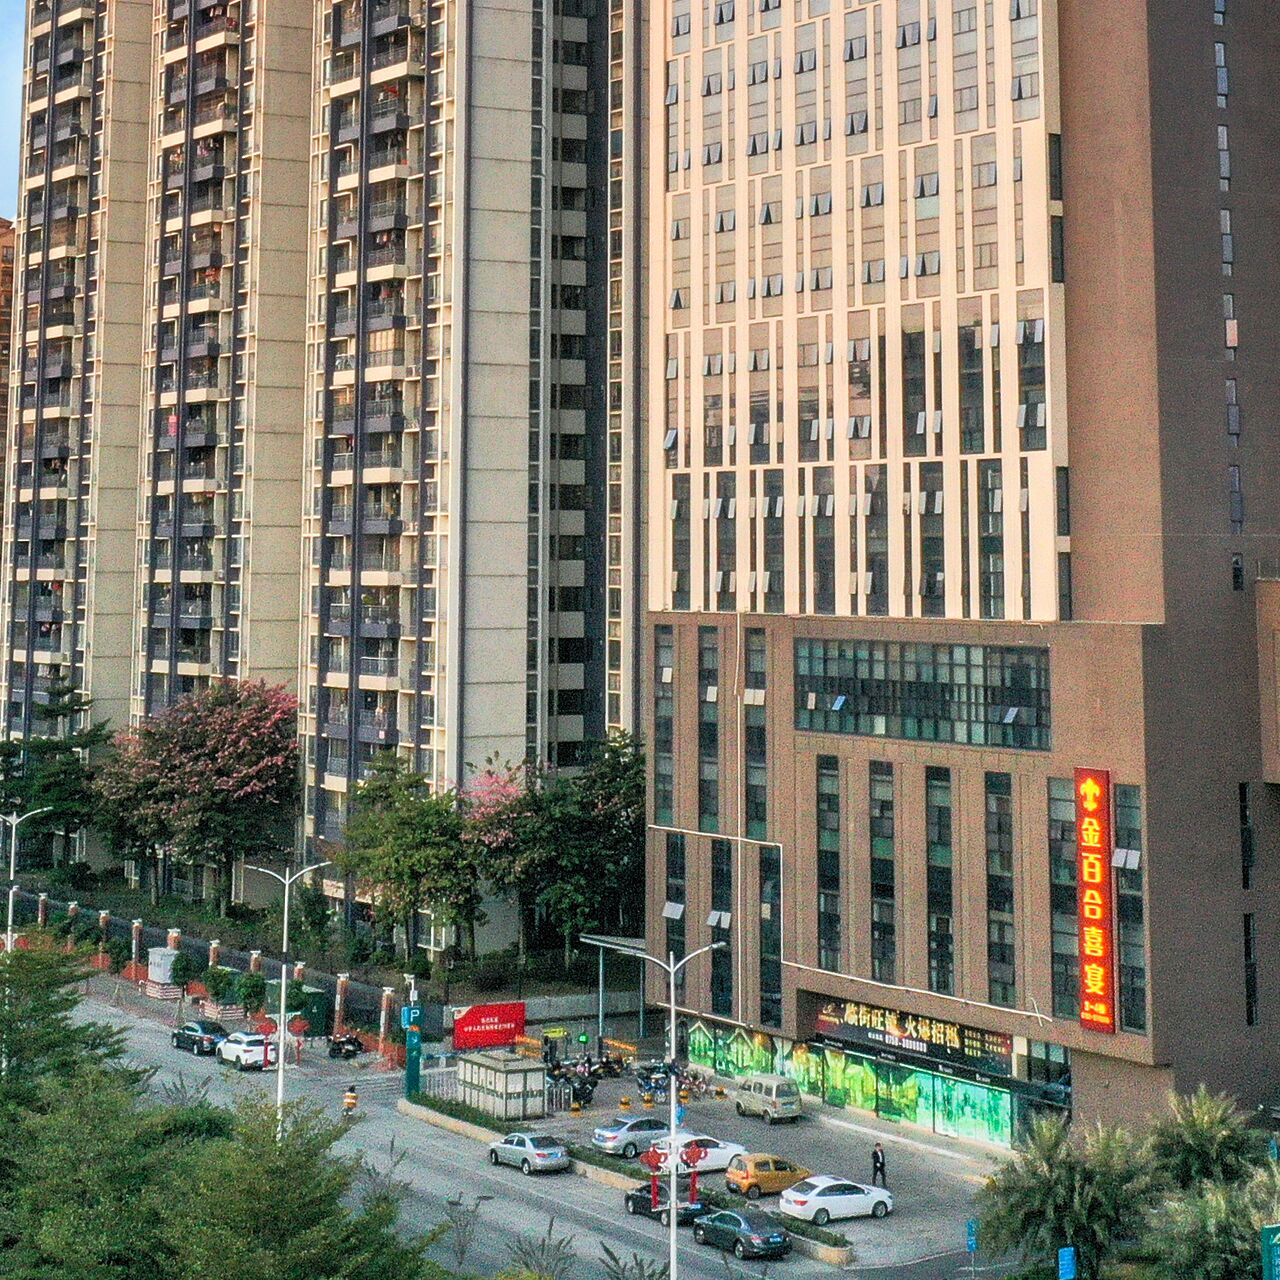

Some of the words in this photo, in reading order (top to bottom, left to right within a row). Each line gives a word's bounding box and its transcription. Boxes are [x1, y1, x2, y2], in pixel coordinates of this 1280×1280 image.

[1080, 816, 1105, 997] 金百合喜宴
[410, 1009, 420, 1023] P
